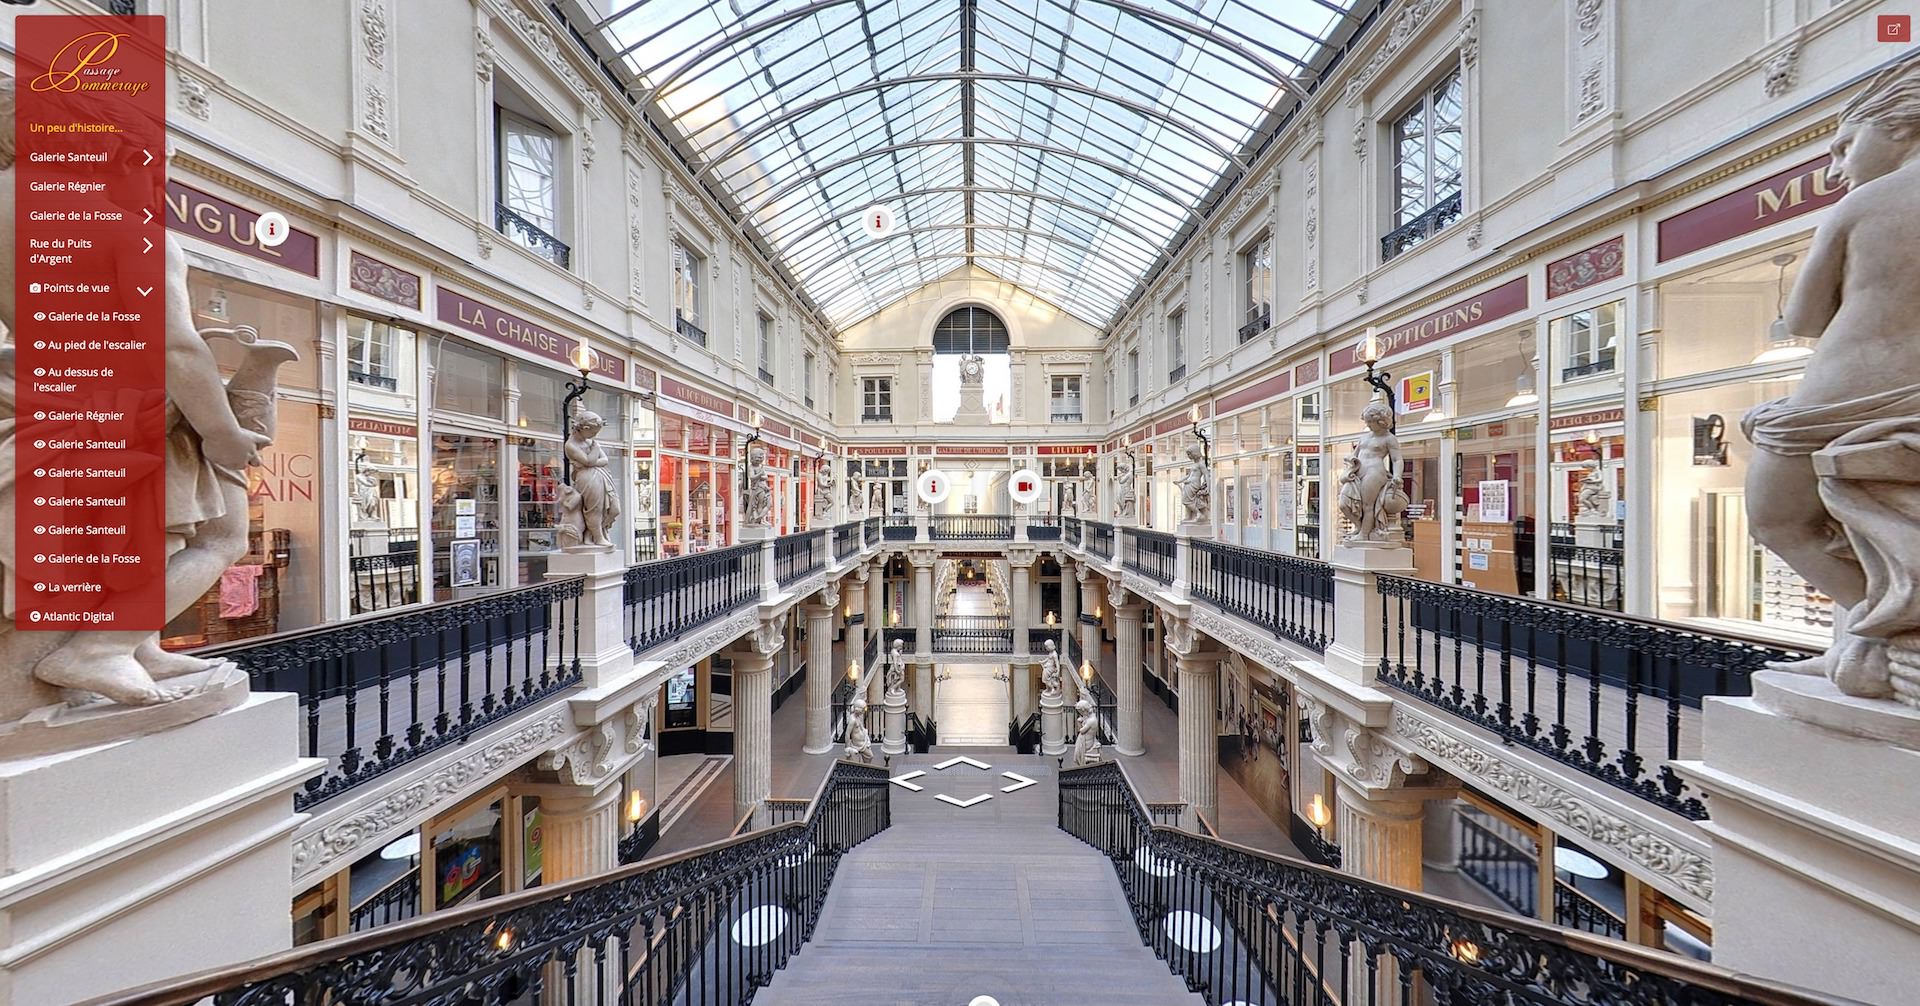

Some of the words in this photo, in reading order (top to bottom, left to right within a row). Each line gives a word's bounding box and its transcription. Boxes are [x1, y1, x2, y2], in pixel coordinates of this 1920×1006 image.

[459, 302, 486, 329] LA
[496, 318, 558, 354] CHAISE
[676, 386, 700, 403] ALICE
[1052, 446, 1083, 454] LILITH
